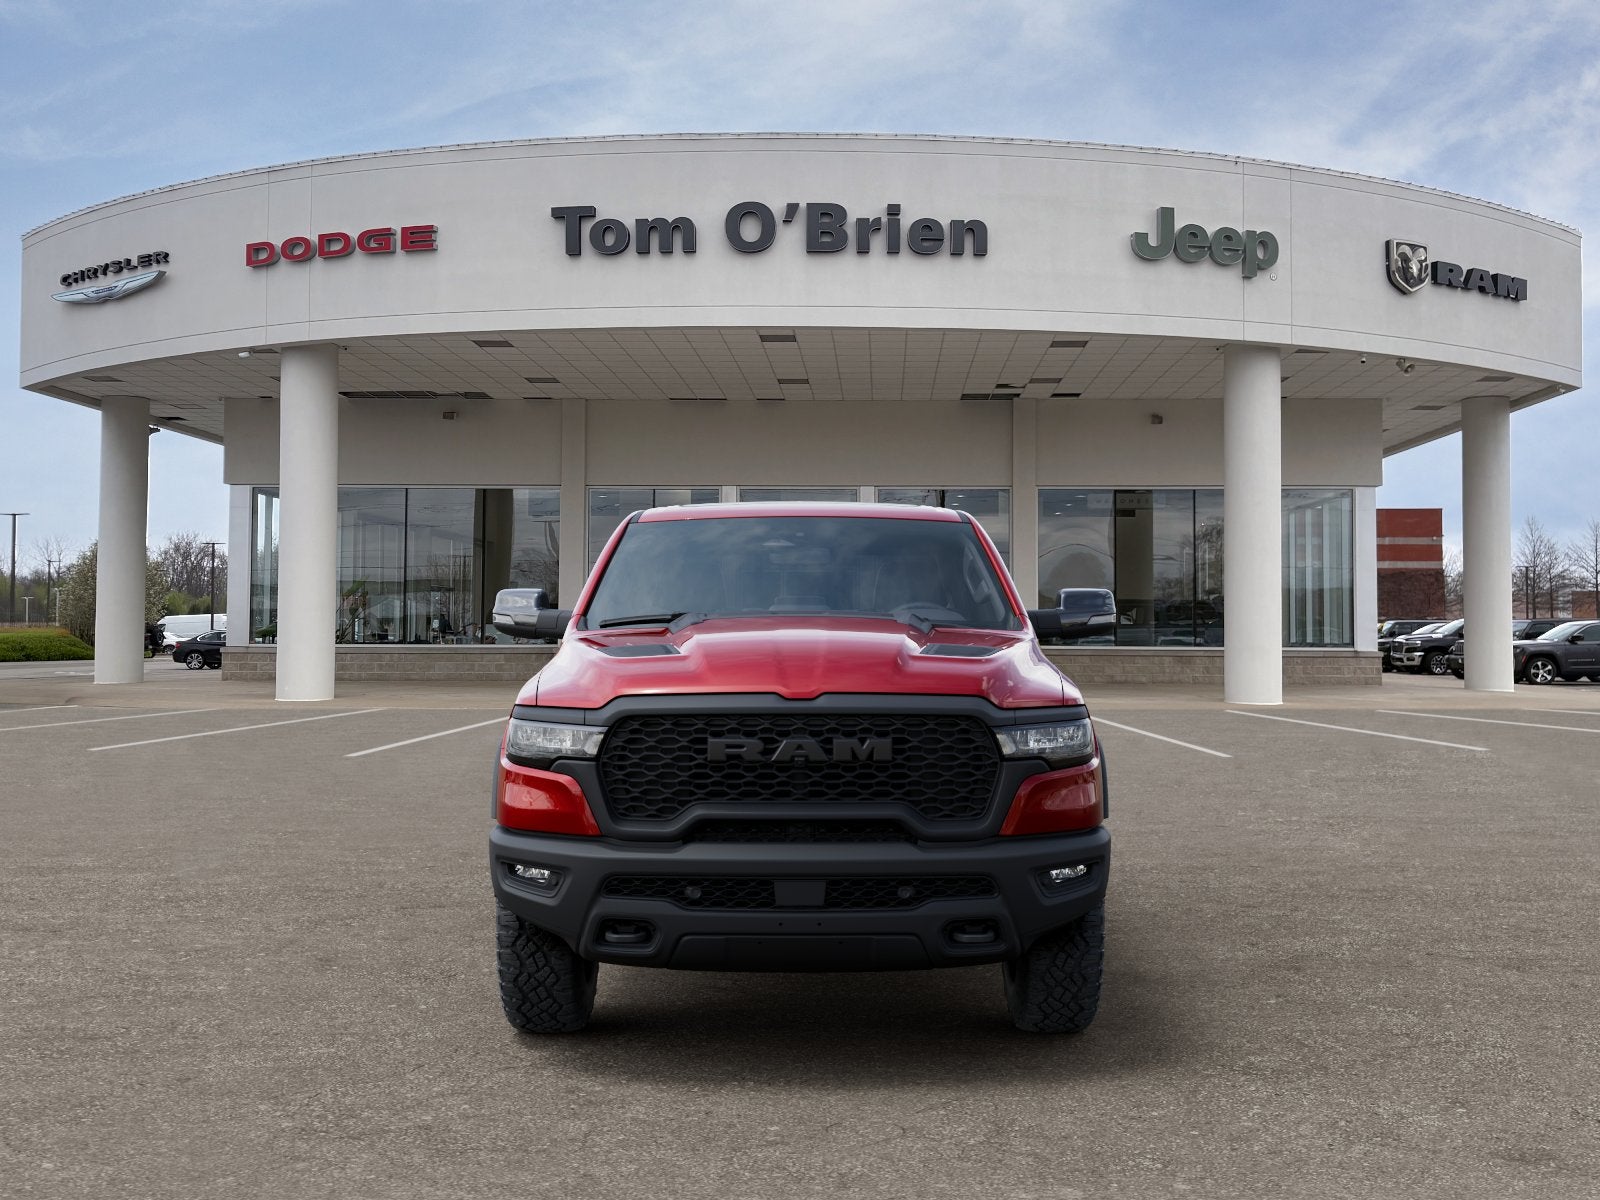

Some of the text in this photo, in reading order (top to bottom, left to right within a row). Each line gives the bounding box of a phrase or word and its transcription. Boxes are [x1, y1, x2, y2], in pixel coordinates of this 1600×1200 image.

[244, 224, 438, 269] DODGE
[550, 200, 989, 257] Tom O'Brien
[1130, 206, 1279, 279] Jeep
[59, 250, 170, 287] CHRYSLER
[1430, 260, 1528, 302] RAM
[706, 735, 893, 763] RAM
